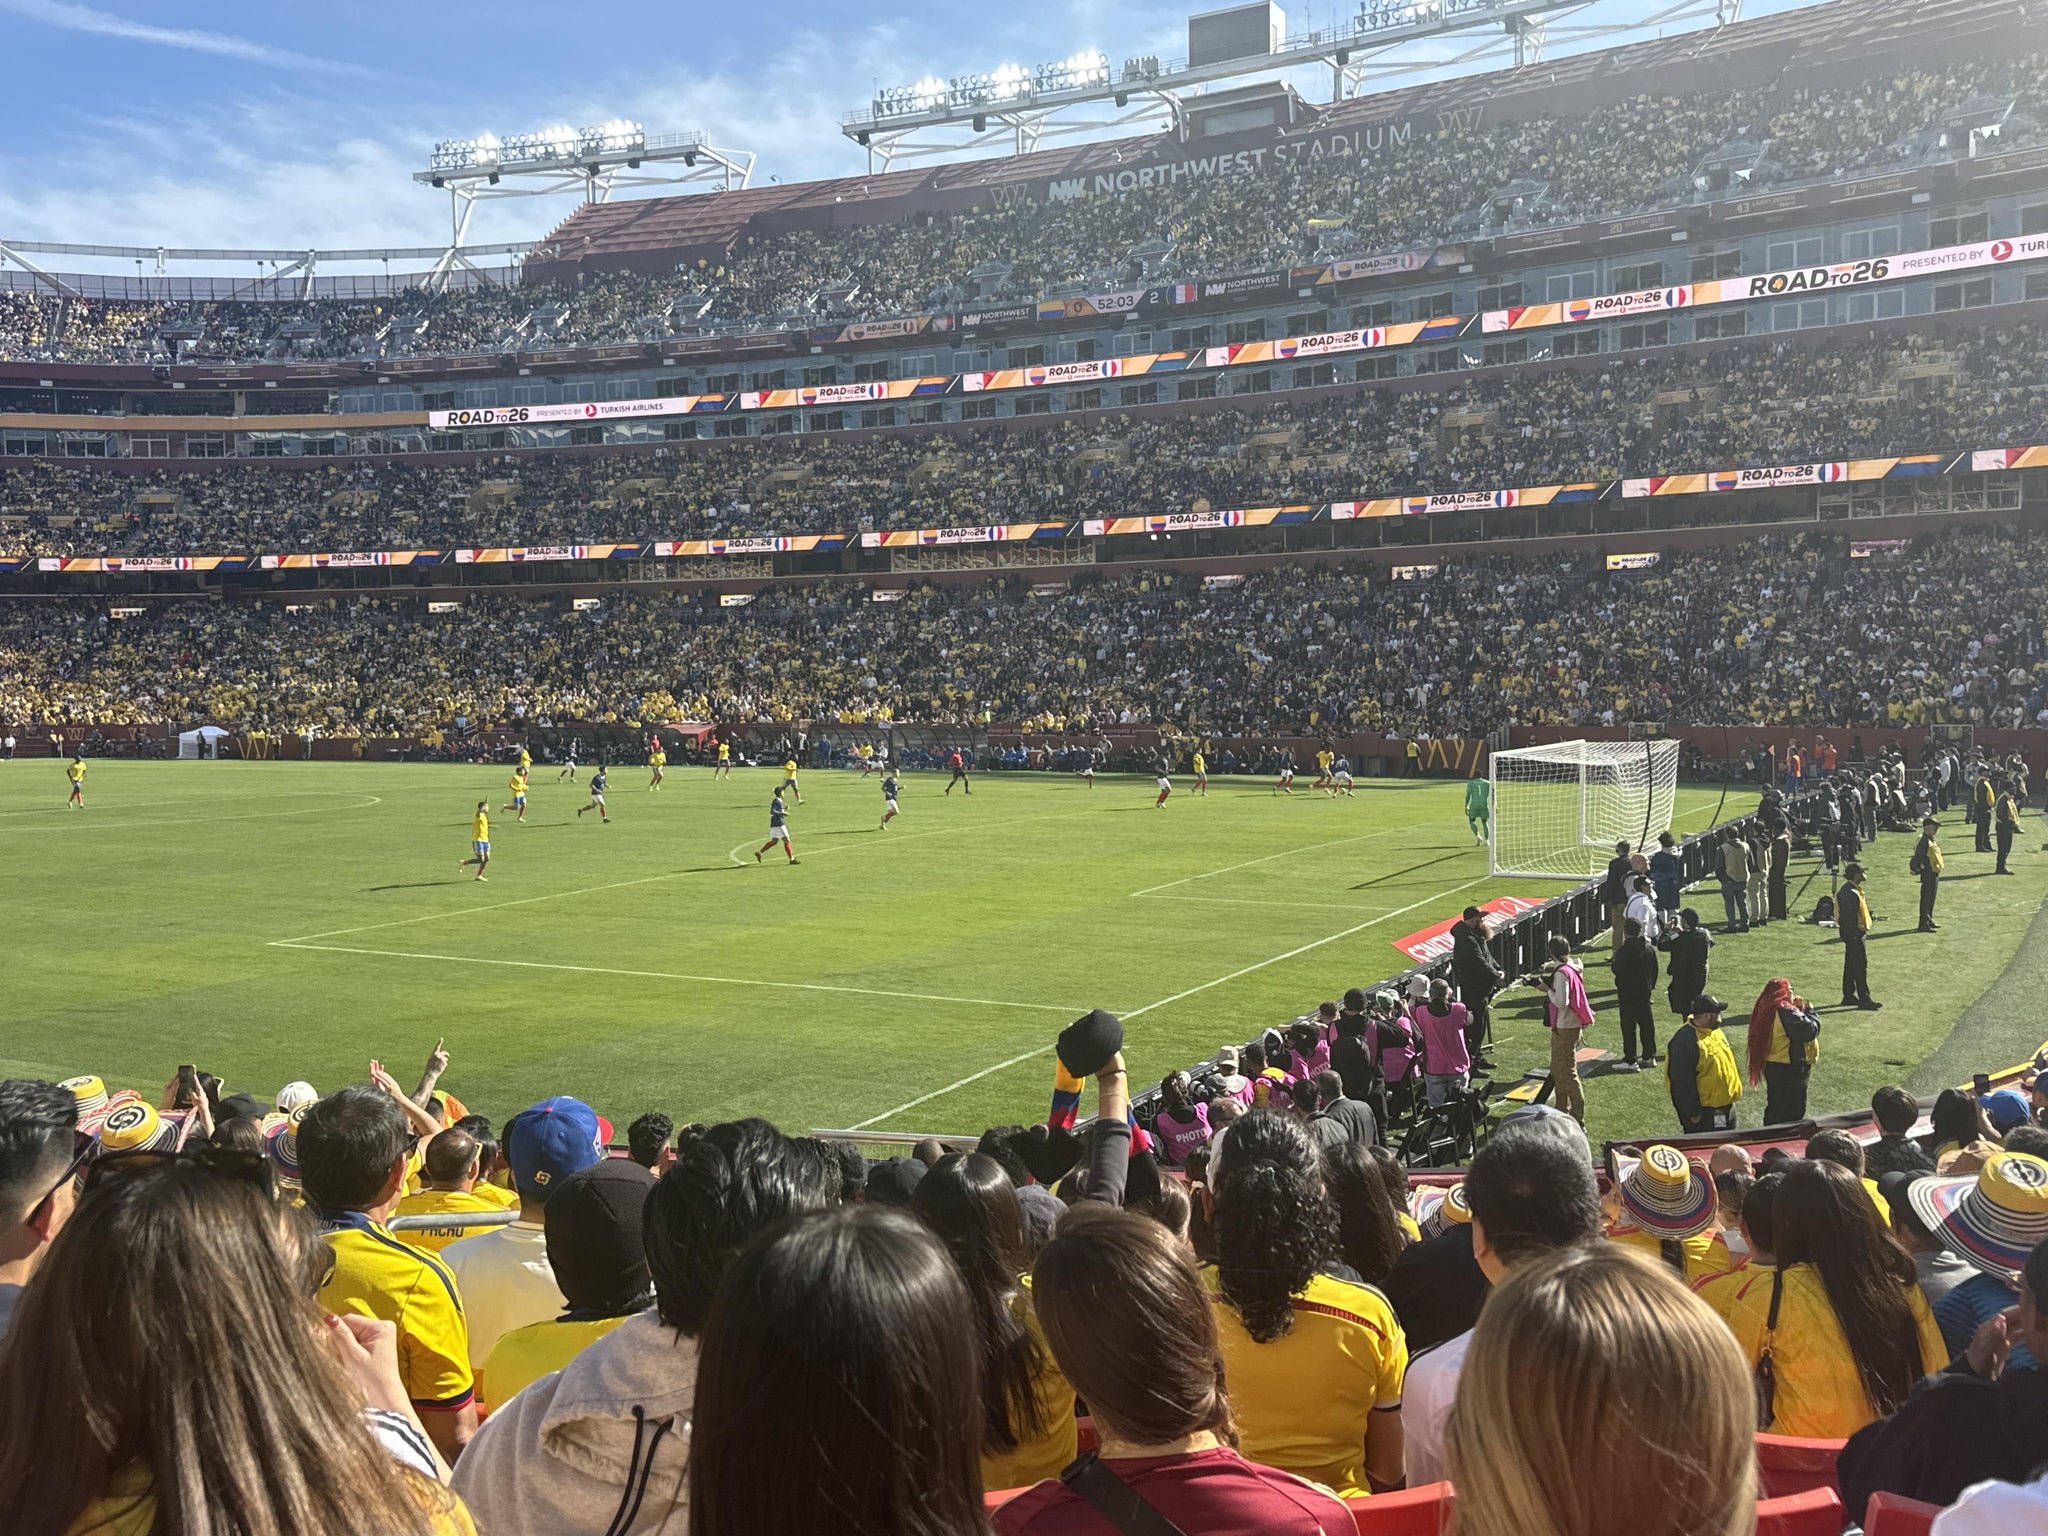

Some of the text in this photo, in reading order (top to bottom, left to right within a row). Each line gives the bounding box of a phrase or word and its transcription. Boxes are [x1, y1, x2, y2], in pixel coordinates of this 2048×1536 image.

[1095, 147, 1268, 194] NORTHWEST
[1274, 121, 1413, 163] STADIUM
[1610, 222, 1622, 234] 20
[1903, 251, 1967, 270] PRESENTED
[1969, 250, 1984, 260] BY
[1228, 274, 1280, 288] NORTHWEST
[1098, 294, 1134, 310] 52:03
[1150, 293, 1159, 304] 2
[982, 308, 1030, 319] NORTHWEST
[600, 404, 631, 414] TURKISH
[632, 403, 664, 412] AIRLINES
[1309, 1062, 1330, 1078] HOTO
[1176, 1128, 1206, 1144] PHOTO
